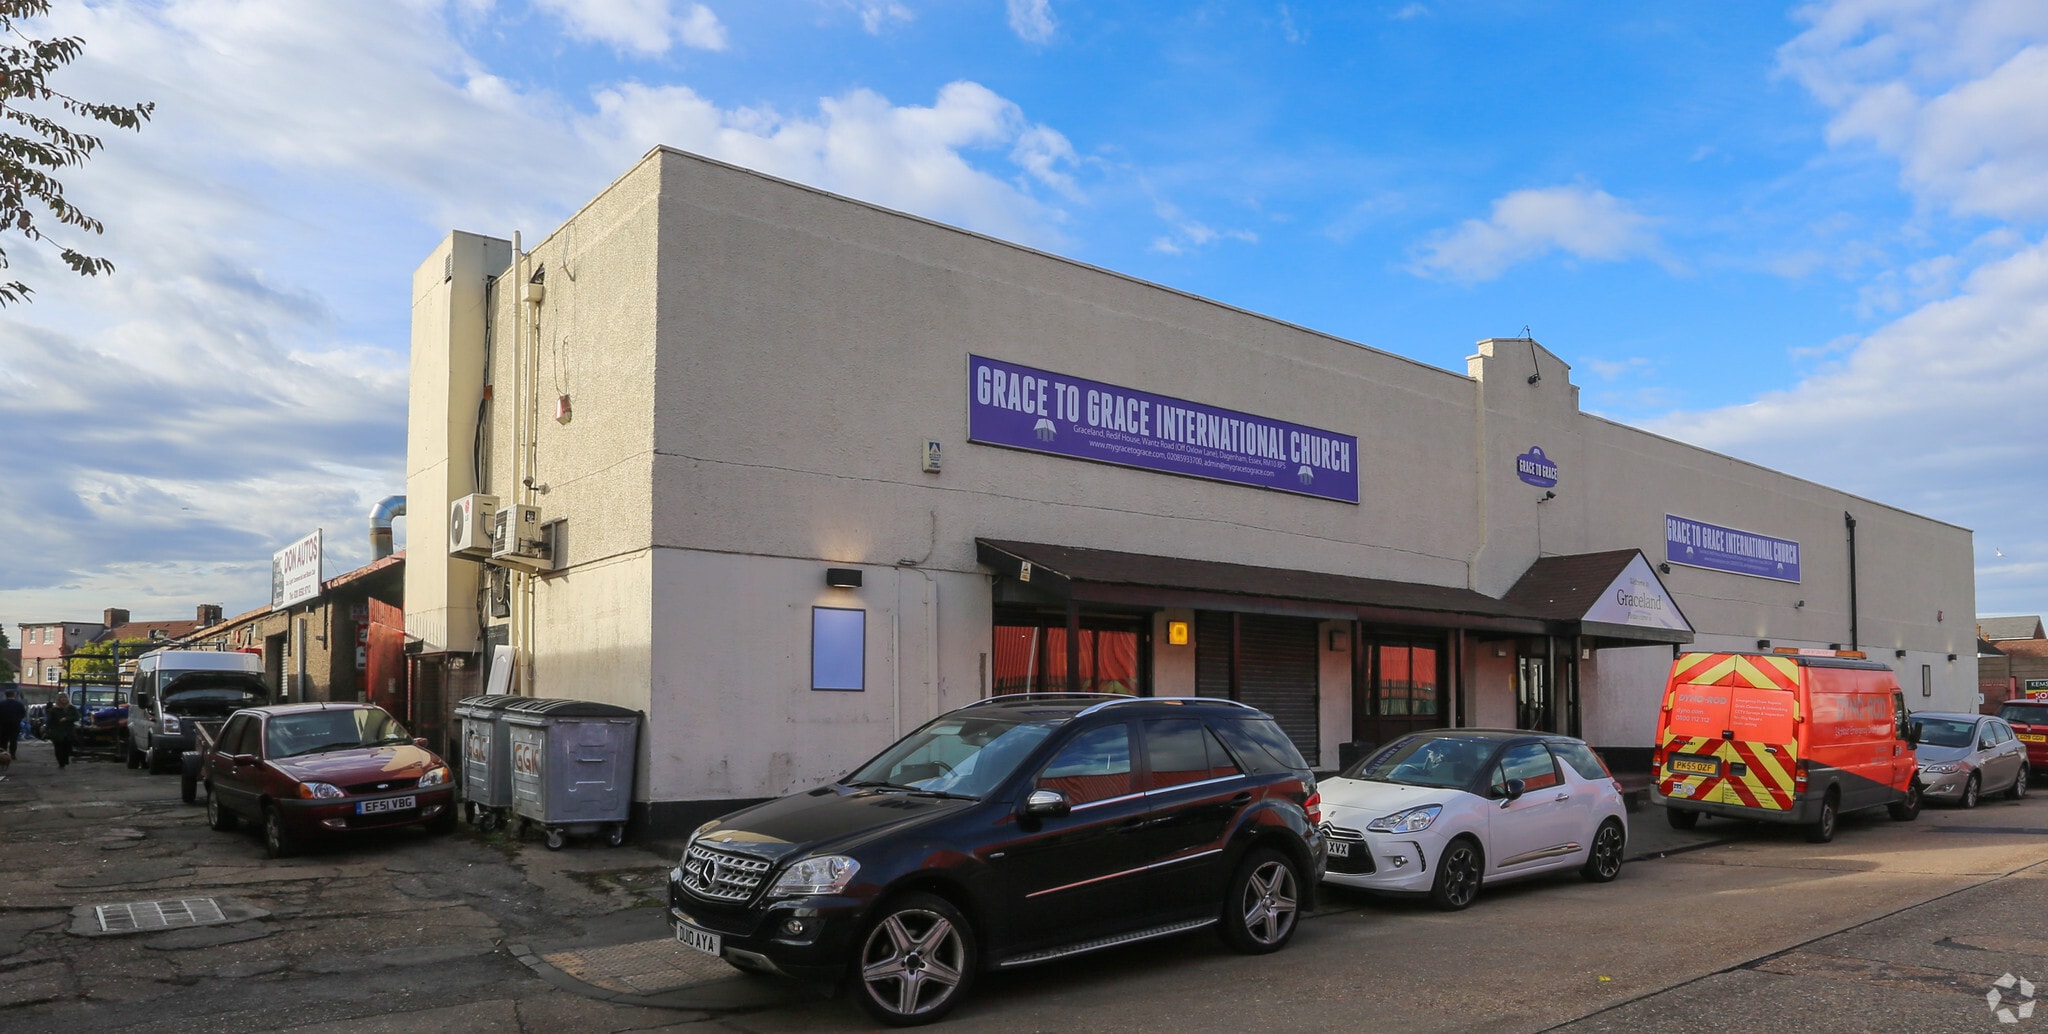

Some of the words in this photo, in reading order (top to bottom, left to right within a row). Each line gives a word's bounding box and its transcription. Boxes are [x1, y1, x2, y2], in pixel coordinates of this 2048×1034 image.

[977, 365, 1048, 417] GRACE
[1055, 382, 1080, 423] TO
[1087, 389, 1150, 437] GRACE
[1156, 404, 1287, 462] INTERNATIONAL
[1290, 431, 1350, 474] CHURCH
[1073, 425, 1105, 438] Graceland,
[1160, 441, 1175, 450] Road
[1519, 459, 1535, 475] GRACE
[1535, 463, 1542, 477] TO
[1542, 465, 1557, 480] GRACE
[1667, 518, 1691, 545] GRACE
[1691, 524, 1701, 547] TO
[1702, 527, 1725, 552] GRACE
[1725, 532, 1773, 561] INTERNATIONAL
[1773, 541, 1797, 565] CHURCH
[284, 547, 297, 573] DON
[297, 535, 318, 568] AUTOS
[1616, 588, 1662, 610] Graceland
[1678, 694, 1728, 705] DYNO-ROD
[514, 743, 539, 772] GGK
[1676, 761, 1696, 770] PK55
[365, 801, 390, 812] EF51
[391, 797, 412, 809] VBG
[1329, 841, 1347, 855] XVX
[680, 925, 694, 946] DU10
[695, 933, 714, 952] AYA
